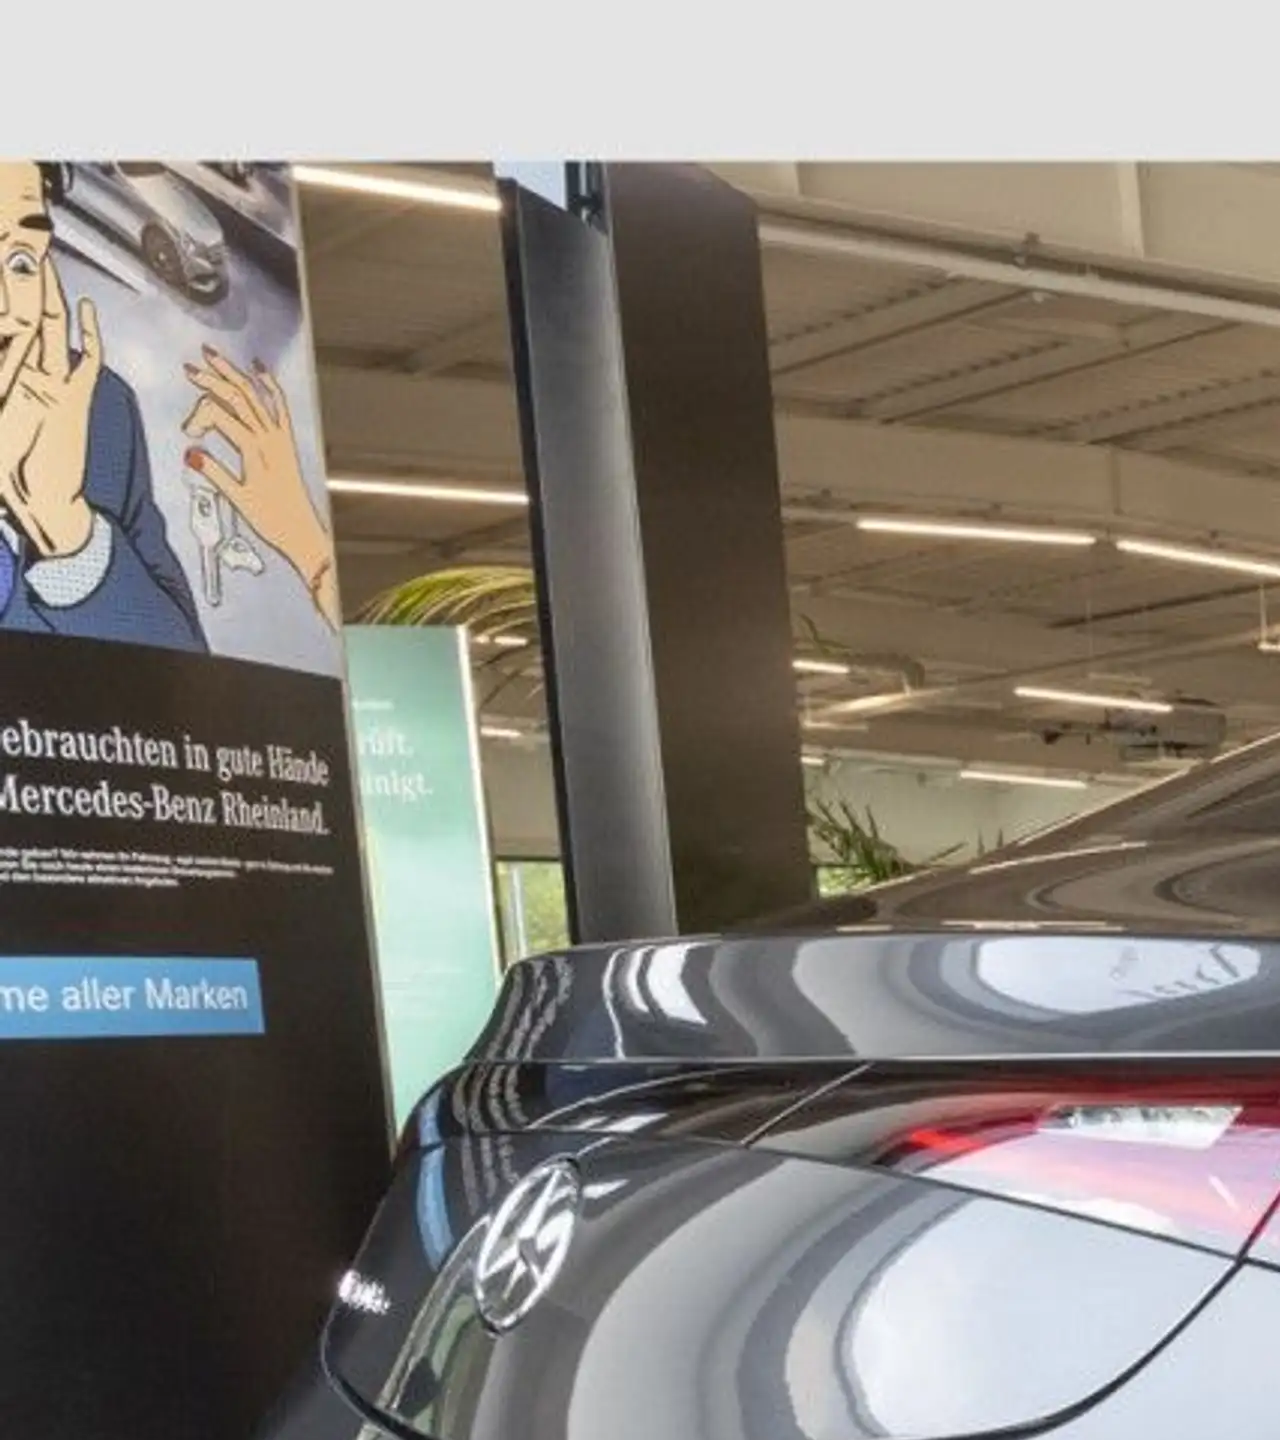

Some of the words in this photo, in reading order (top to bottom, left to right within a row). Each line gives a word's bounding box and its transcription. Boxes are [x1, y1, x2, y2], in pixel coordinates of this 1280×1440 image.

[1, 717, 180, 770] ebrauchten
[183, 734, 213, 774] in
[216, 744, 264, 784] gute
[265, 743, 331, 788] Hände
[219, 789, 334, 837] Rheinland.
[61, 974, 138, 1012] aller
[144, 976, 250, 1012] Marken
